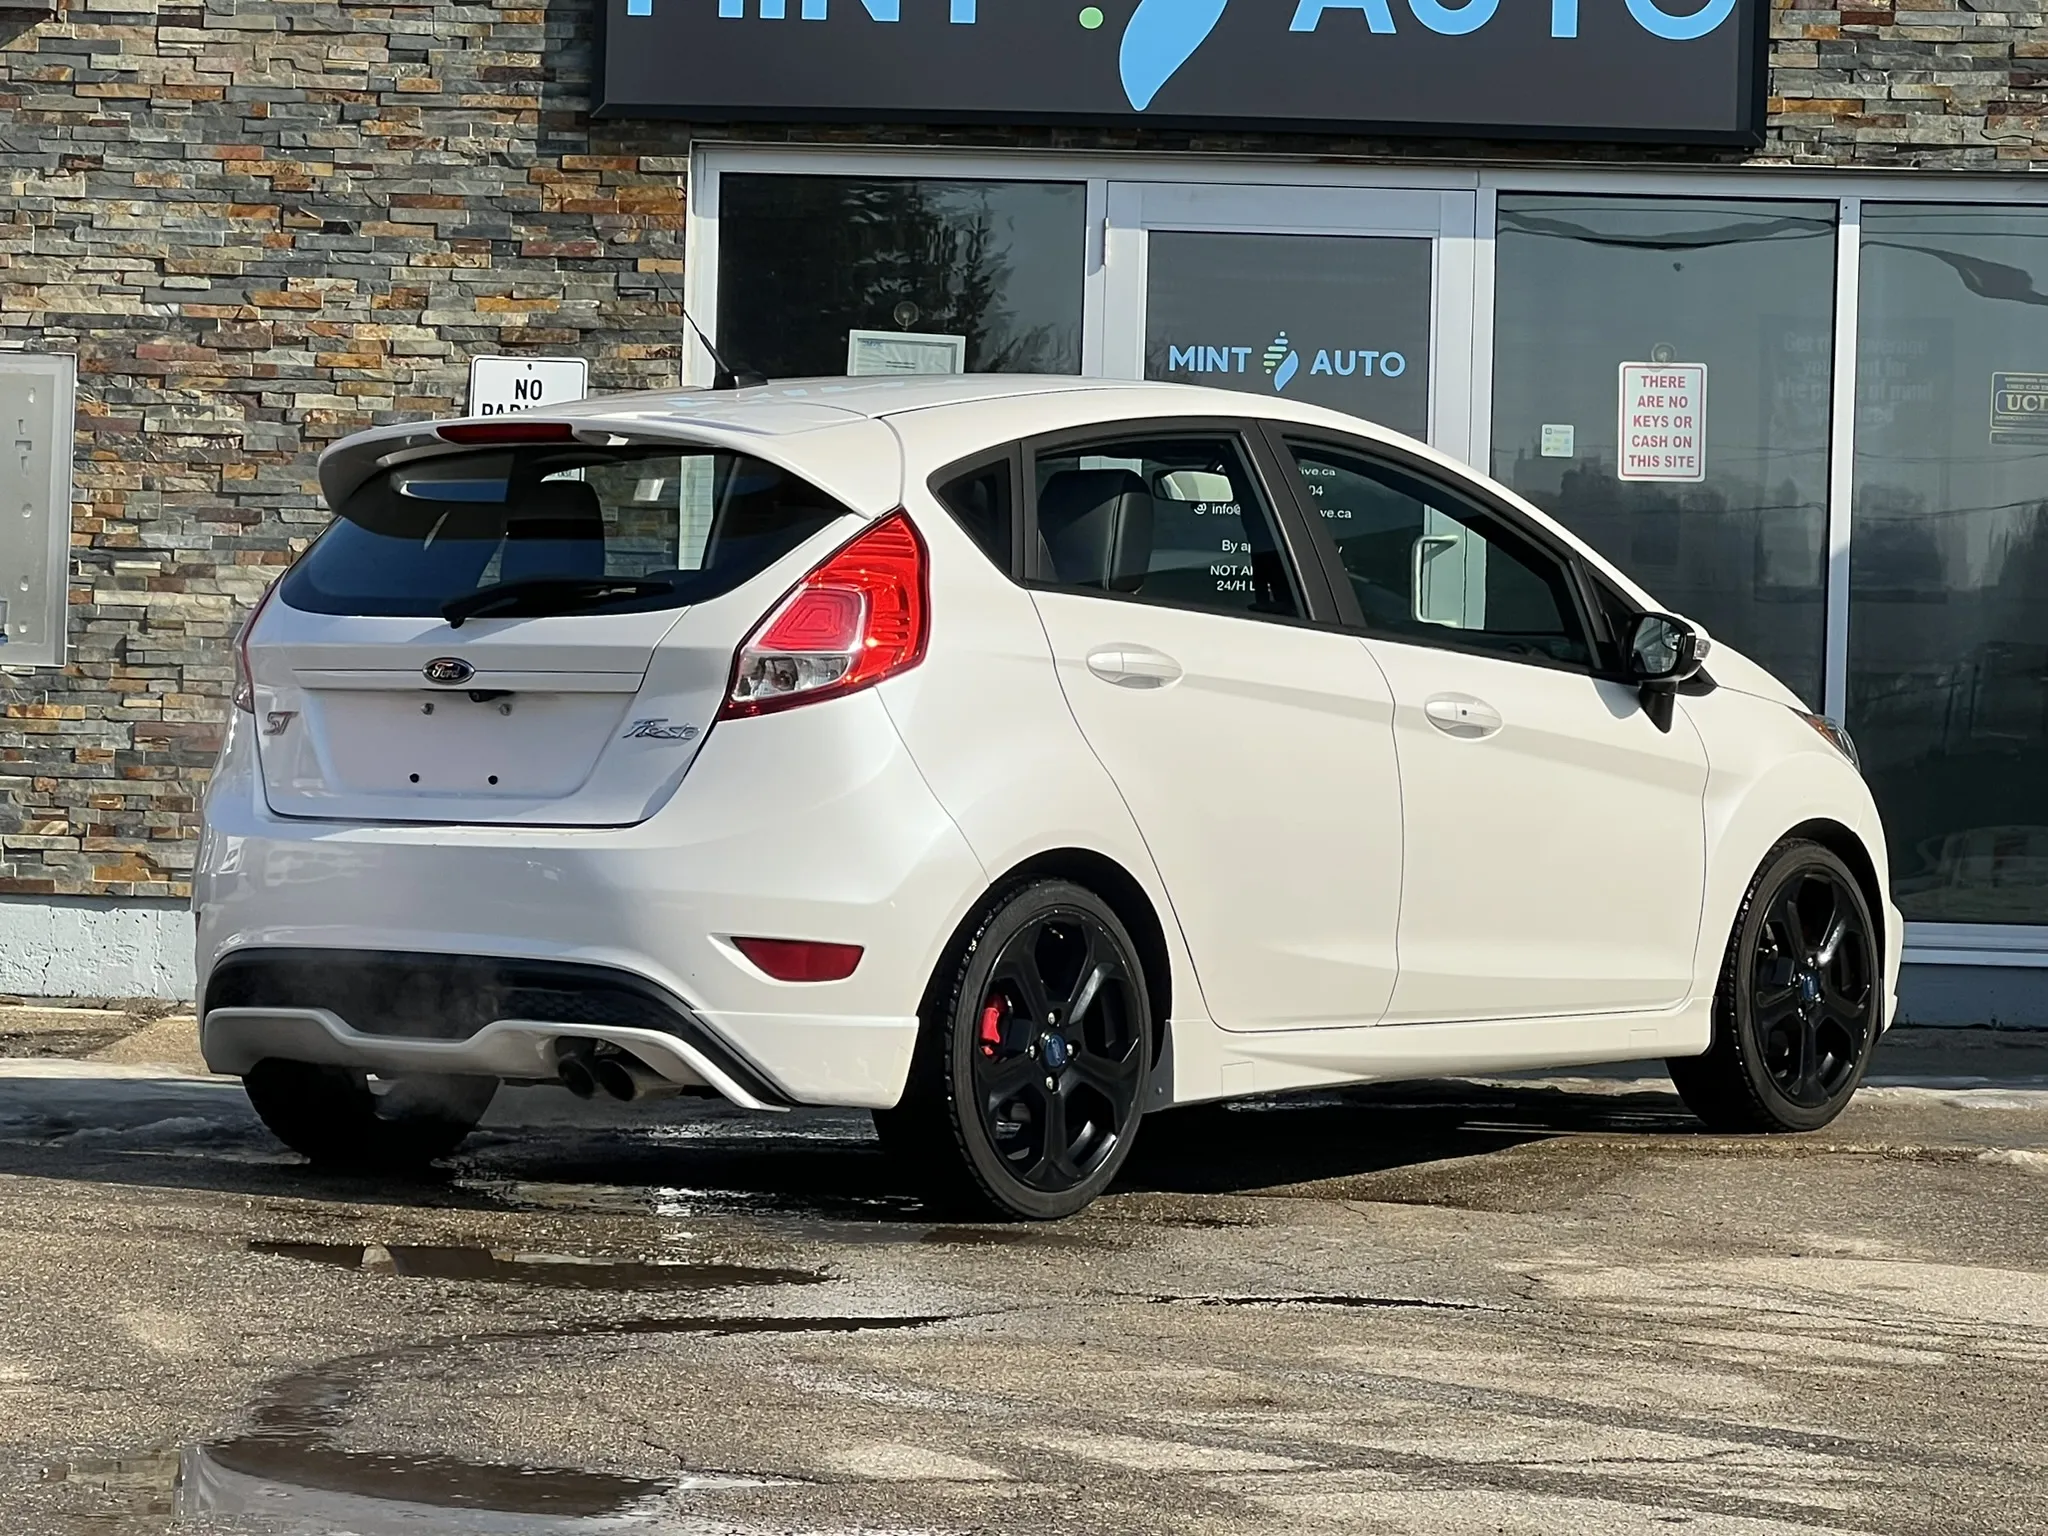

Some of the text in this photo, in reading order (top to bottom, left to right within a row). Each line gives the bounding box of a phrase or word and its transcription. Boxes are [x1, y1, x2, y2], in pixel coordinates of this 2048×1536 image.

[1169, 345, 1406, 378] MINT AUTO
[1640, 375, 1686, 389] THERE
[515, 379, 543, 401] NO
[1637, 395, 1688, 408] ARE NO
[1633, 415, 1692, 429] KEYS OR
[1631, 435, 1692, 448] CASH ON
[1629, 454, 1695, 468] THIS SITE
[1299, 466, 1336, 476] ive.ca
[1221, 539, 1238, 554] By
[1210, 564, 1238, 576] NOT
[1216, 580, 1246, 591] 24/H
[432, 662, 461, 678] Ford
[262, 711, 299, 736] ST
